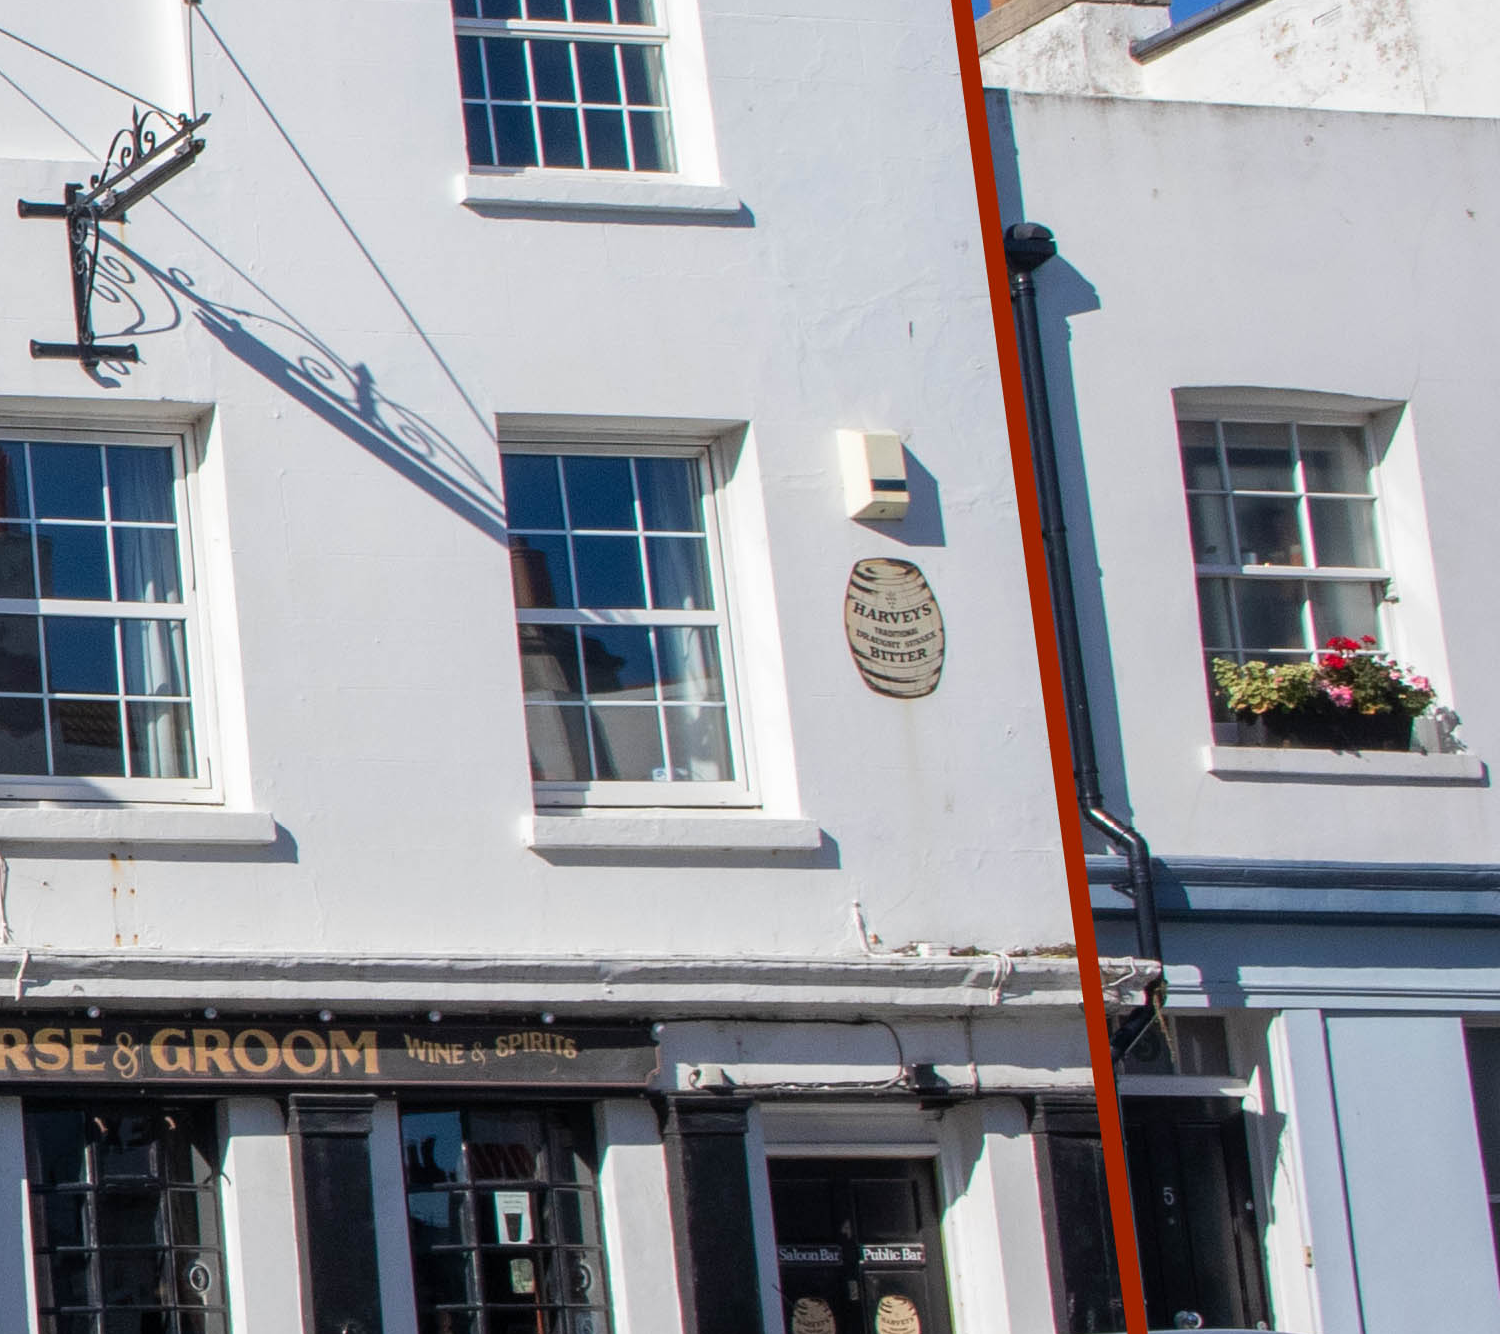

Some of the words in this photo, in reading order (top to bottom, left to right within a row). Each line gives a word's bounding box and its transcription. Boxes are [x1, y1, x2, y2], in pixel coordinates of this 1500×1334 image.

[853, 602, 932, 624] HARVEYS
[870, 646, 928, 663] BITTER
[112, 1031, 140, 1080] &
[150, 1027, 380, 1074] GROOM
[404, 1033, 466, 1064] WINE
[471, 1041, 486, 1065] &
[495, 1031, 578, 1059] SPIRITS
[779, 1248, 820, 1262] Saloon
[820, 1248, 841, 1262] Bar
[863, 1248, 901, 1262] Public
[902, 1249, 923, 1262] Bar
